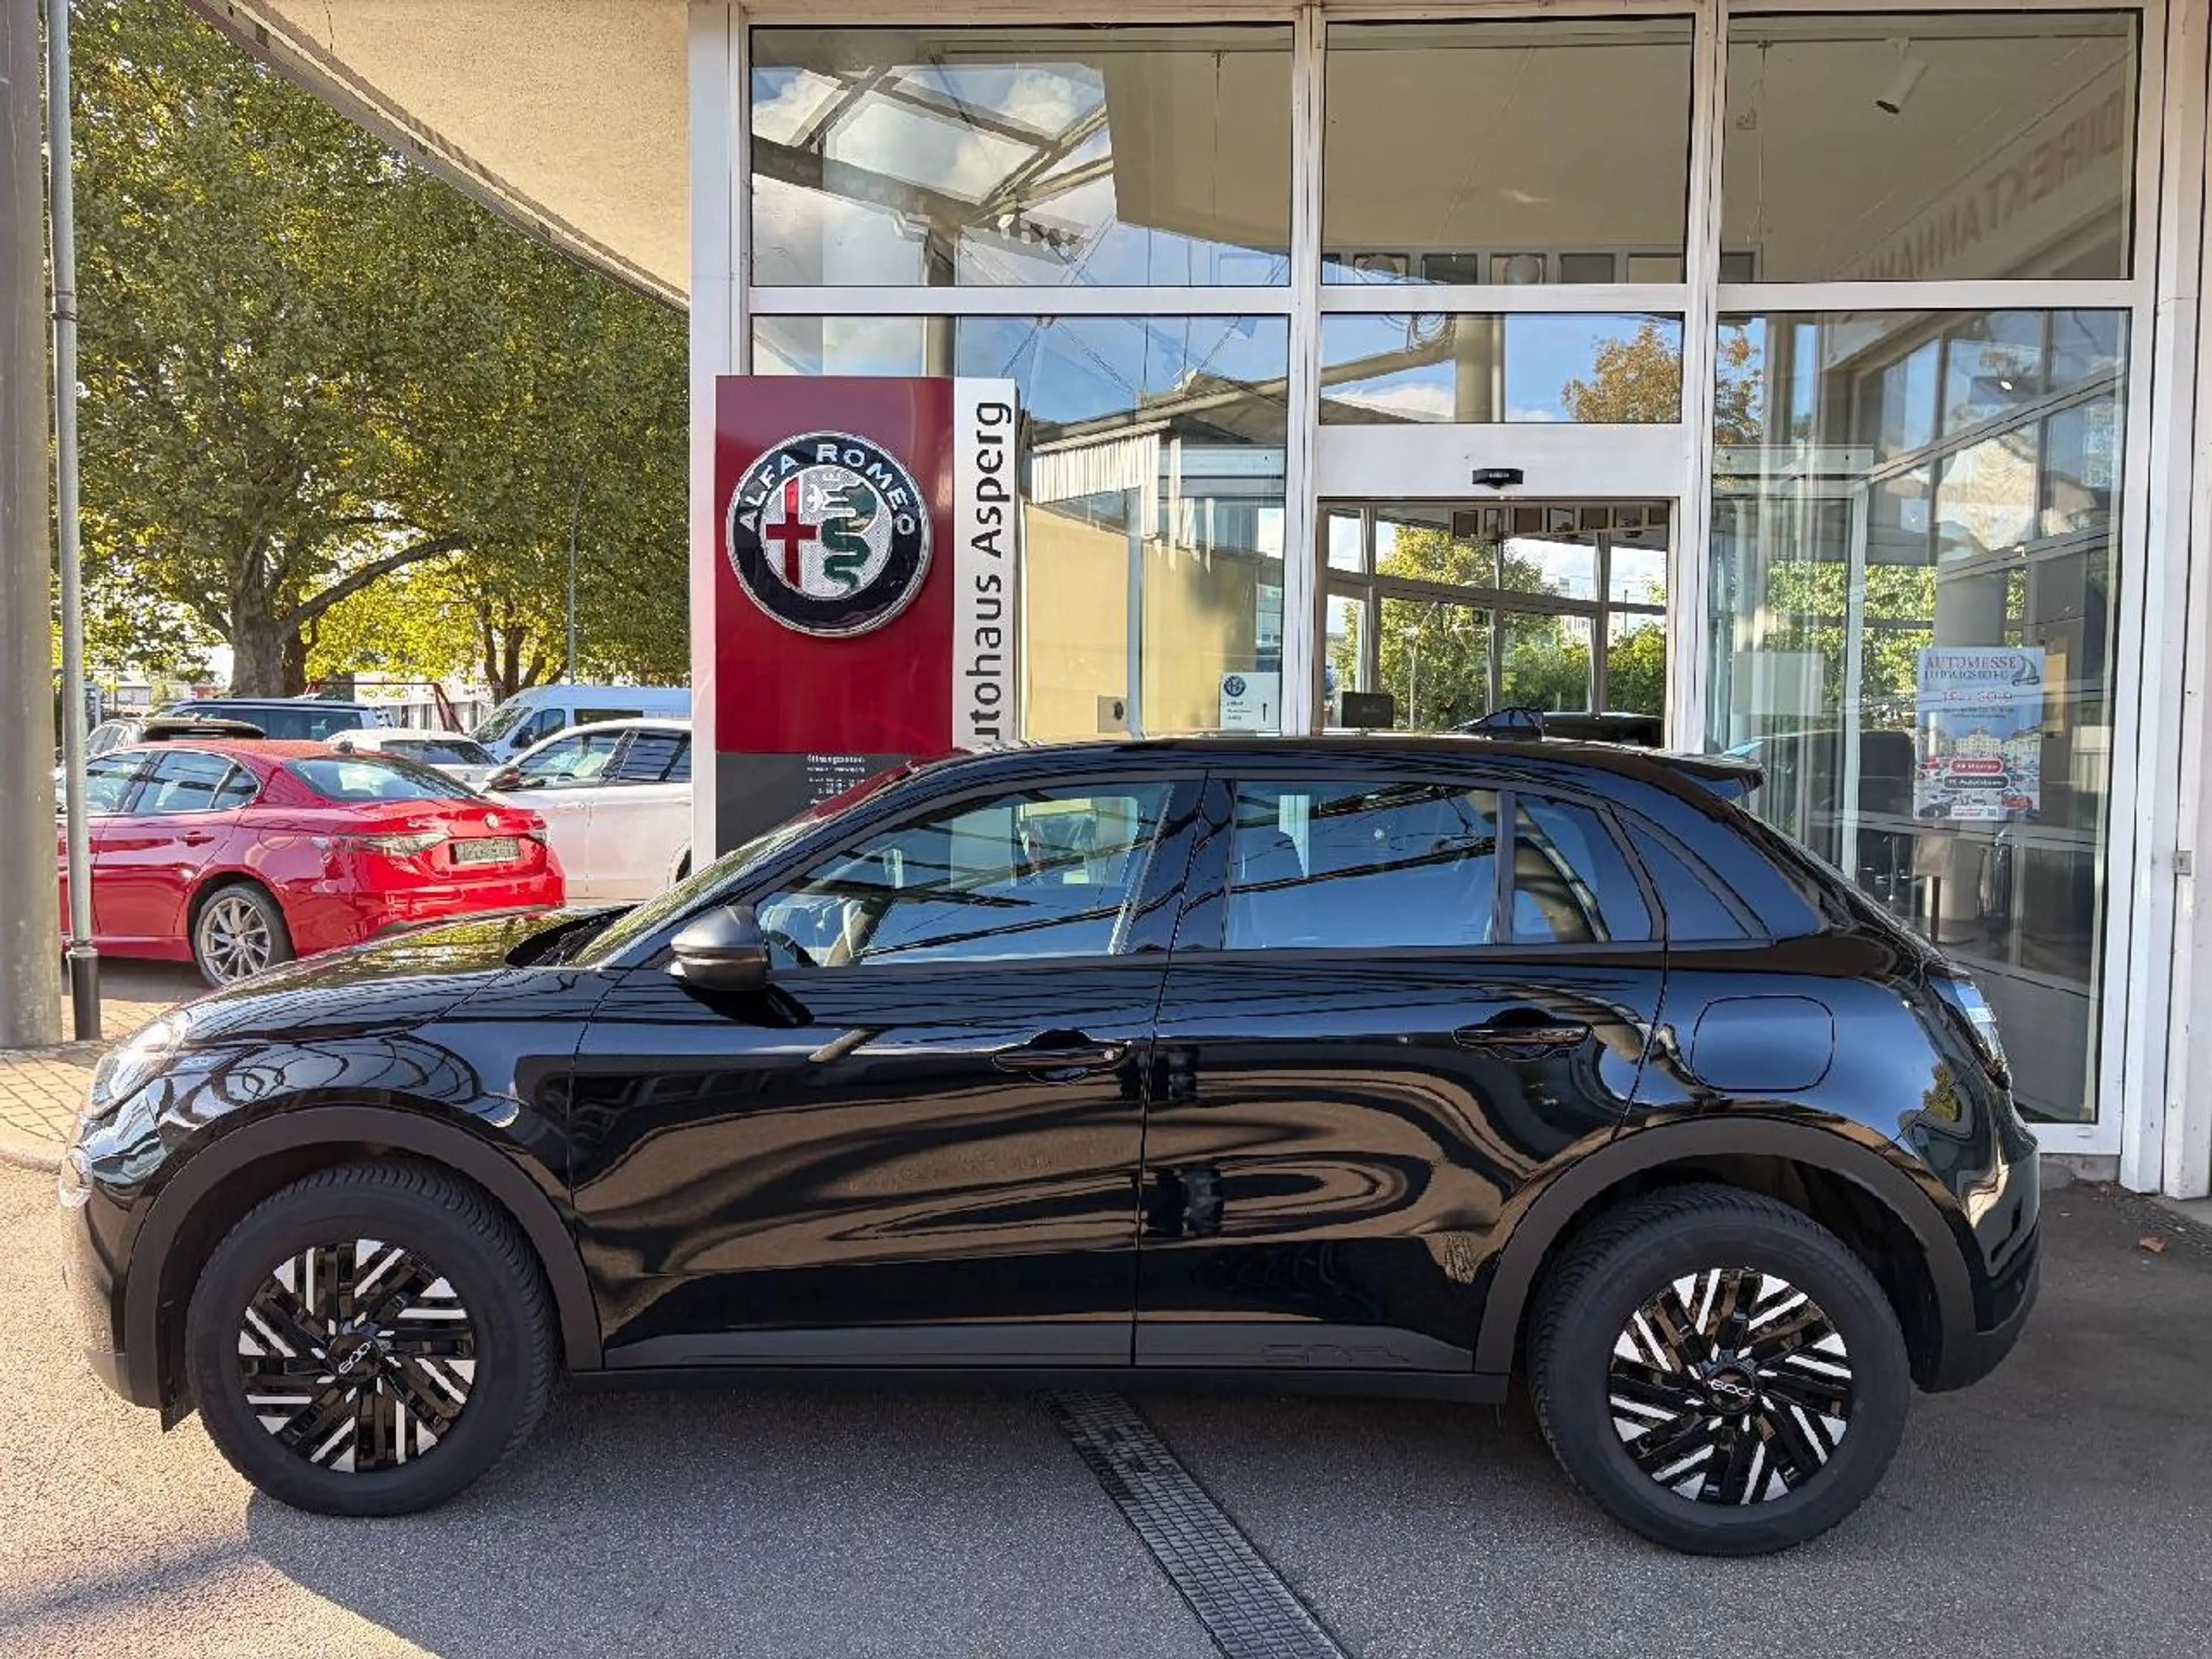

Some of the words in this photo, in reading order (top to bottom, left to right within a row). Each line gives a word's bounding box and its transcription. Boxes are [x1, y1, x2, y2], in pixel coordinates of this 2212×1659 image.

[740, 454, 800, 533] ALFA
[816, 444, 916, 535] ROMEO
[971, 402, 1012, 559] Asperg
[965, 574, 1002, 741] utohaus
